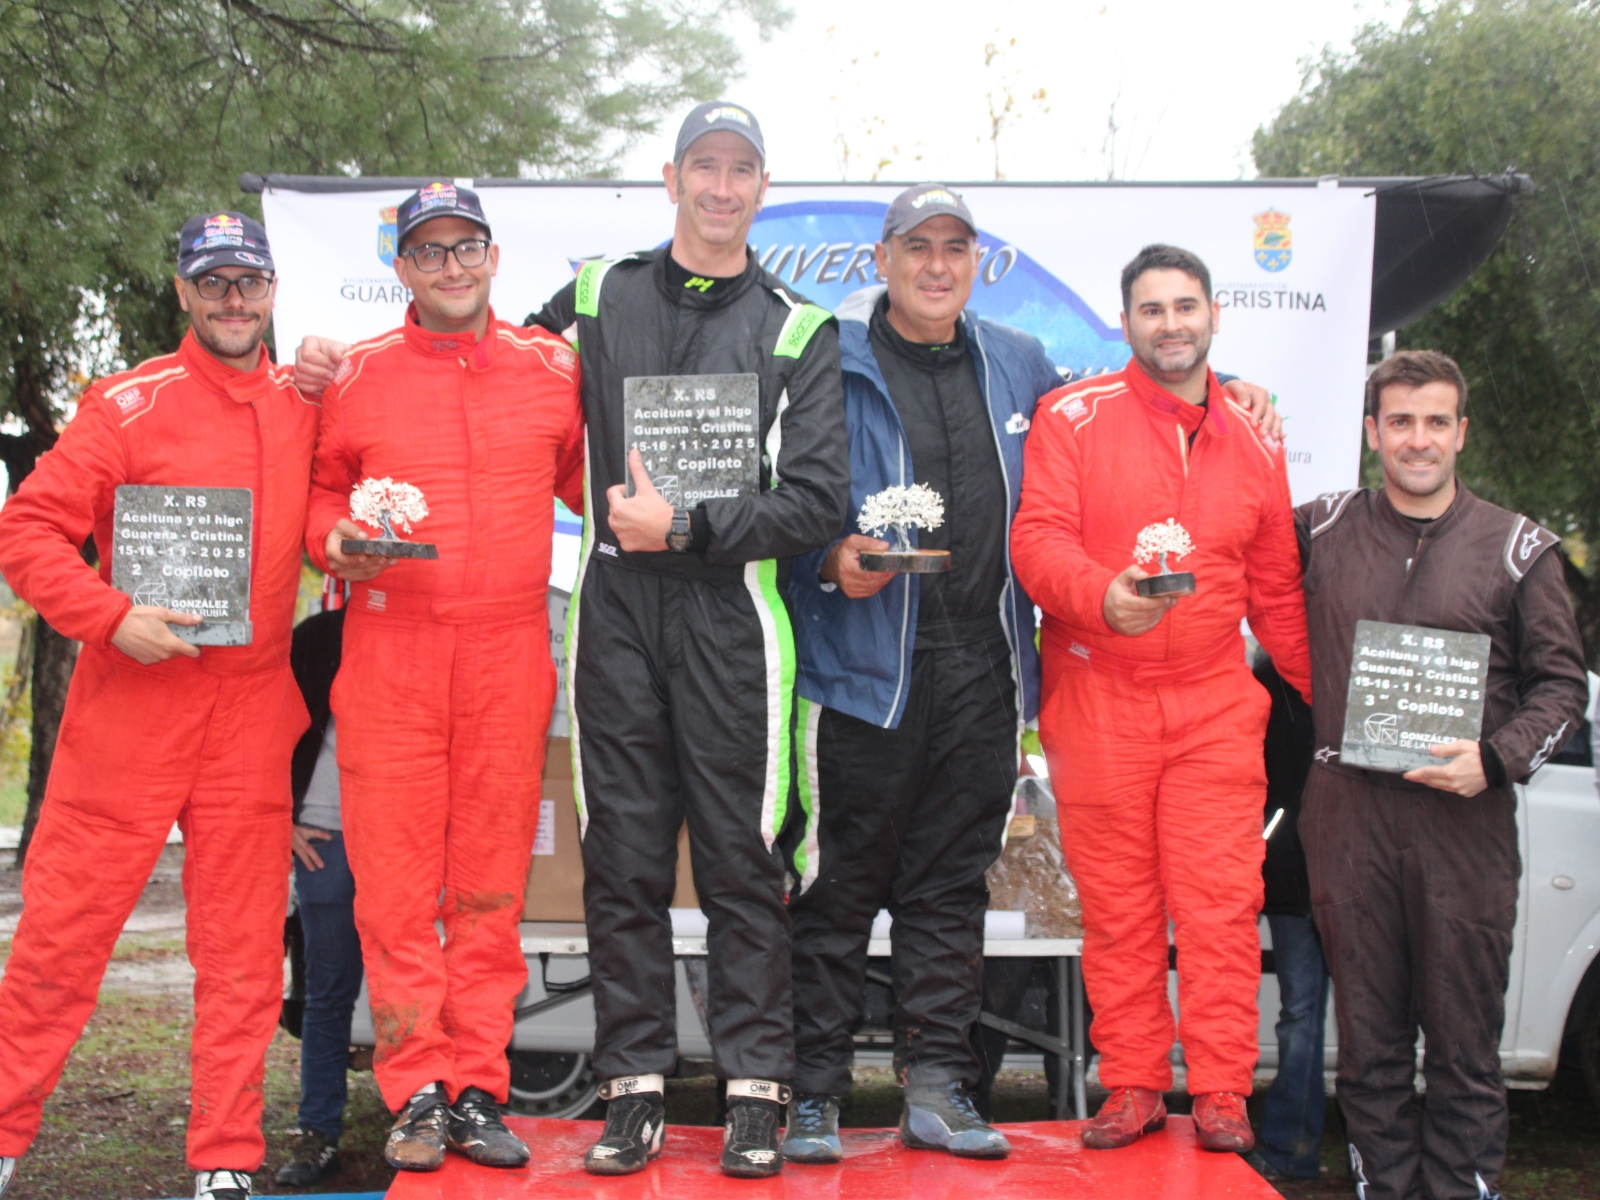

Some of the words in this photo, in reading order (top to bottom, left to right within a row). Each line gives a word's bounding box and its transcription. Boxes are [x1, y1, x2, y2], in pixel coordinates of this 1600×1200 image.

[1215, 290, 1327, 312] CRISTINA
[117, 388, 140, 405] OMP
[634, 408, 692, 419] Aceituna
[724, 406, 752, 418] higo
[701, 422, 752, 434] Cristina
[677, 458, 742, 472] Copiloto
[684, 488, 740, 500] GONZÁLEZ
[186, 495, 207, 508] RS
[122, 512, 182, 524] Aceituna
[198, 514, 210, 524] el
[215, 514, 244, 528] higo
[190, 531, 244, 542] Cristina
[132, 564, 142, 576] 2
[162, 565, 230, 580] Copiloto
[172, 598, 228, 608] GONZÁLEZ
[1422, 636, 1444, 649] RS
[1360, 646, 1419, 662] Aceituna
[1422, 655, 1431, 666] y
[1434, 656, 1447, 666] el
[1450, 657, 1480, 670] higo
[1426, 670, 1478, 685] Cristina
[1396, 698, 1464, 717] Copiloto
[1400, 732, 1458, 744] GONZÁLEZ
[1400, 739, 1414, 748] DE
[1416, 741, 1428, 749] LA
[617, 1080, 638, 1091] OMP
[750, 1083, 772, 1094] OMP
